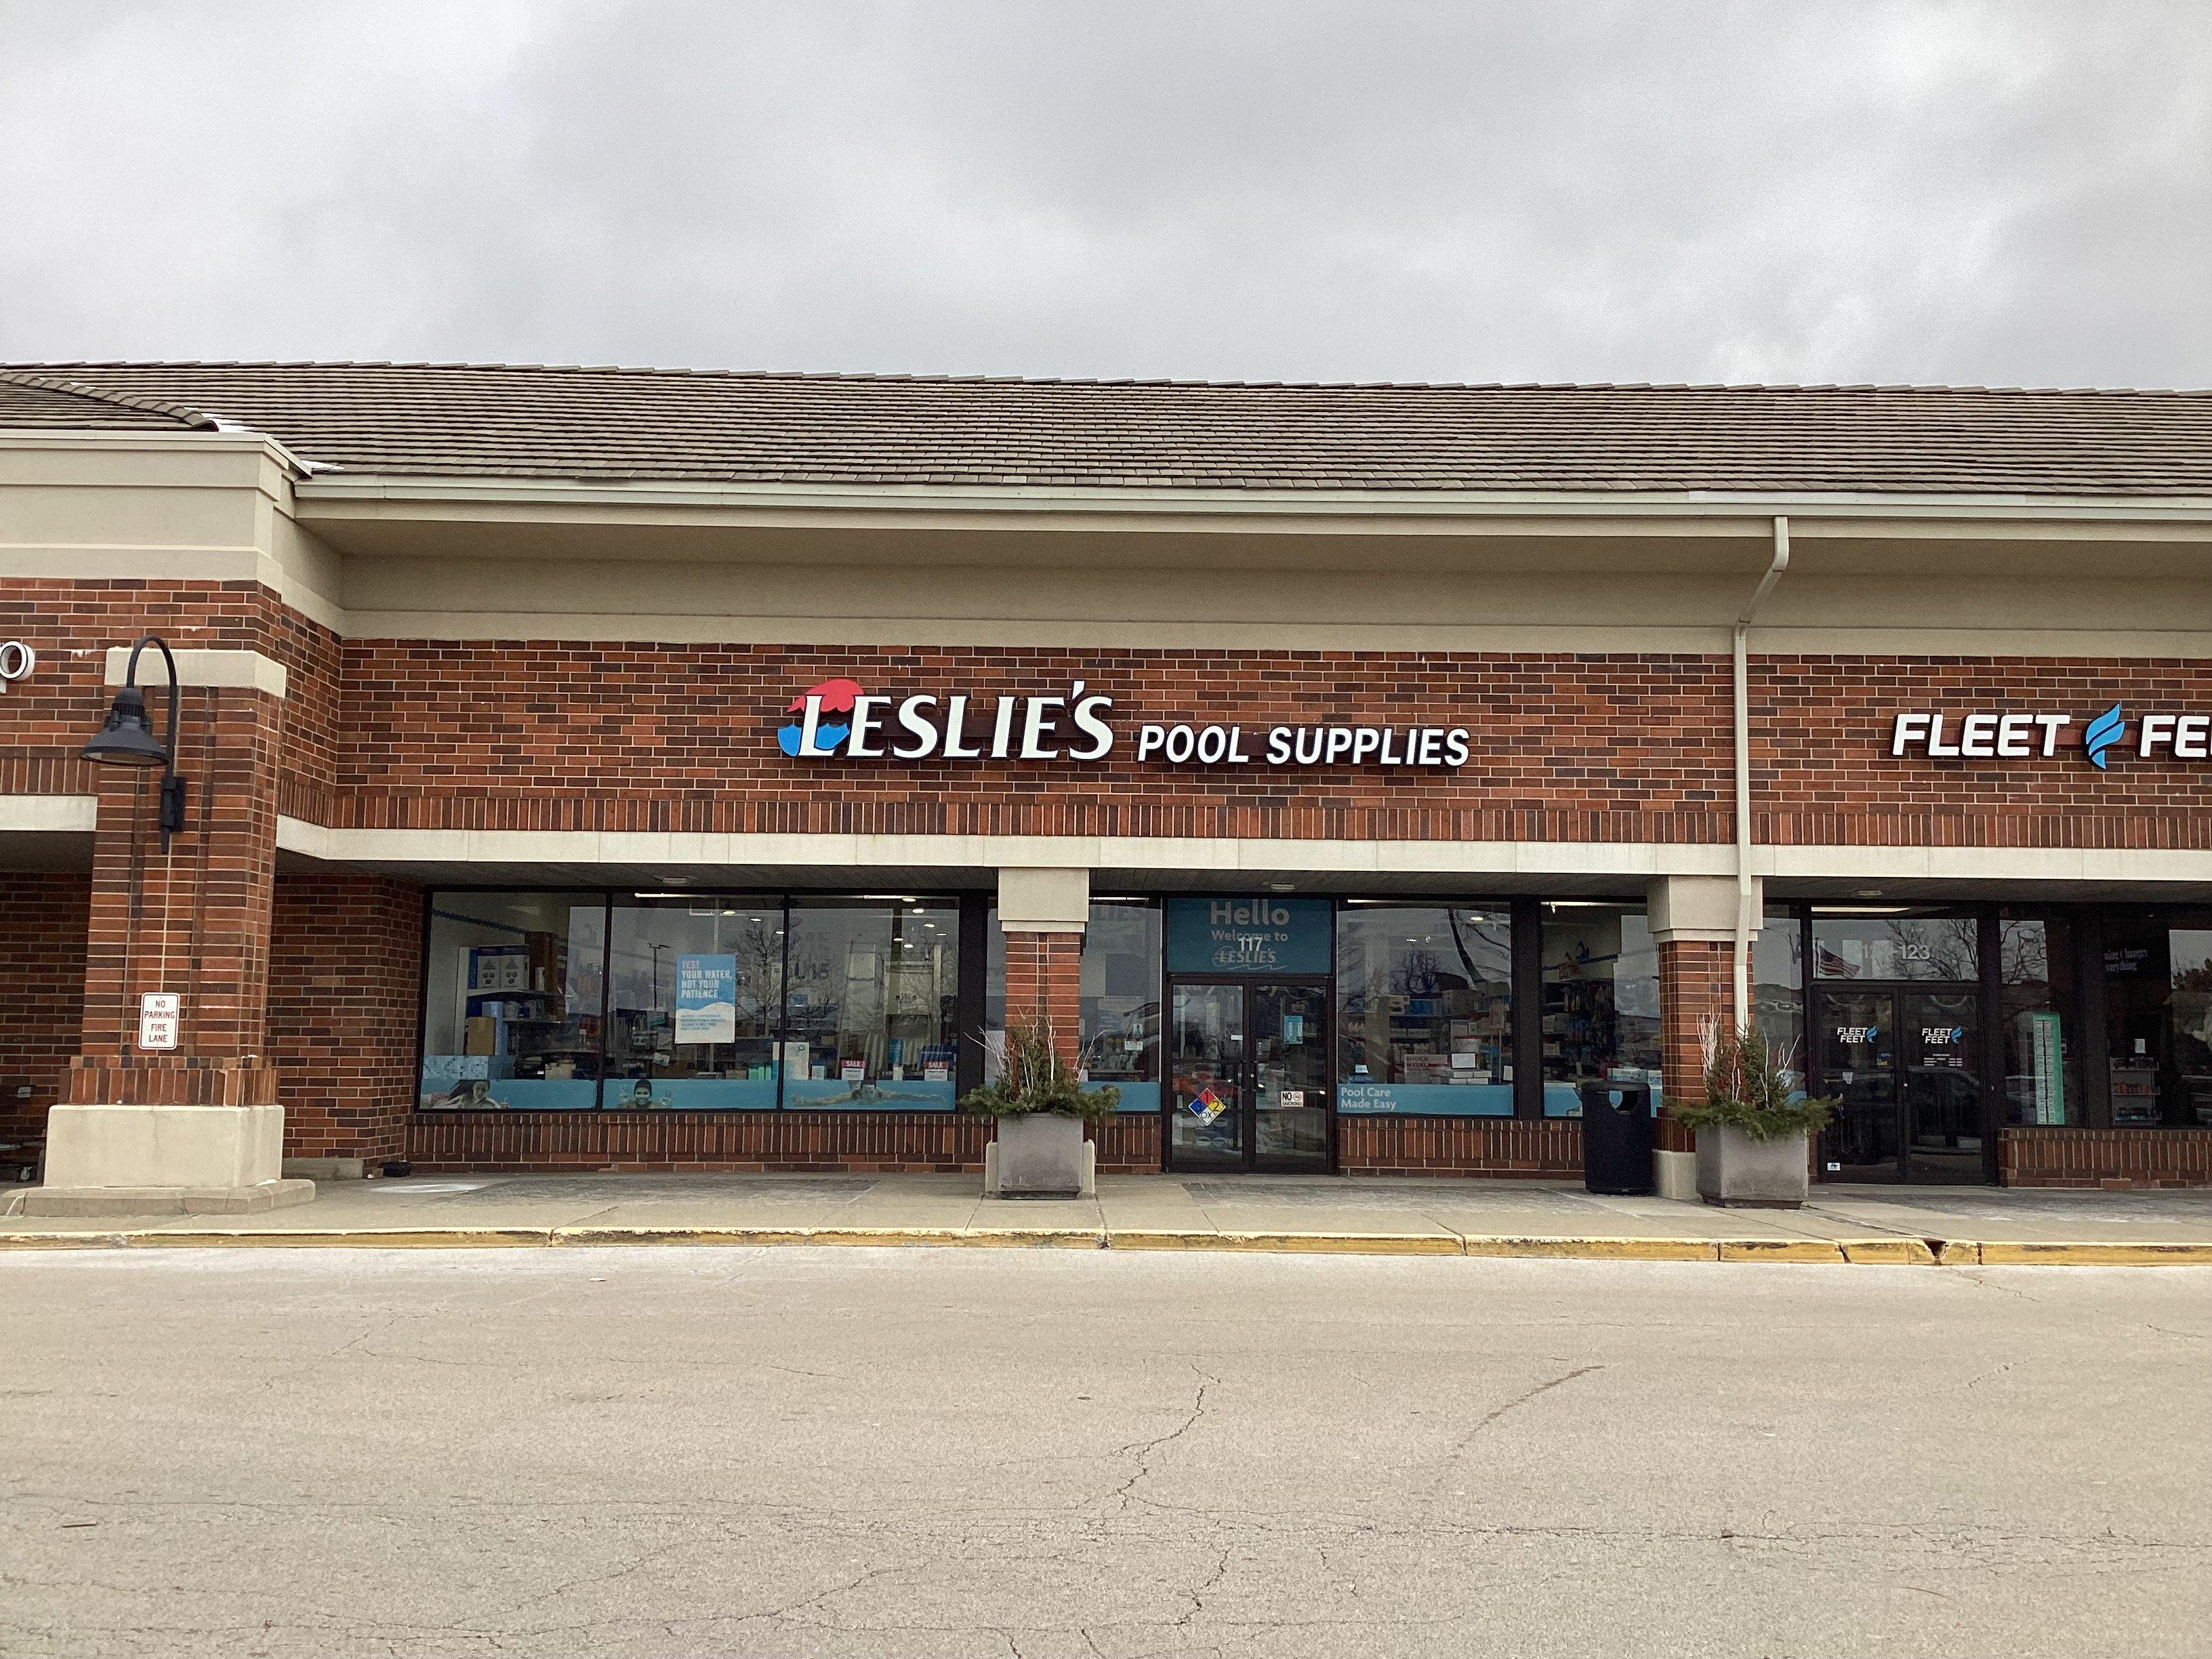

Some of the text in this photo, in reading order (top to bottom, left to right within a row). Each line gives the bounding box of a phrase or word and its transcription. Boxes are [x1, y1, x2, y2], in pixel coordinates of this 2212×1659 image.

[797, 680, 1471, 766] LESLIE'S POOL SUPPLIES
[1892, 713, 2212, 758] FLEET FE
[1210, 899, 1290, 926] Hello
[1210, 929, 1288, 941] Welcome to
[1237, 937, 1263, 951] 117
[1899, 945, 1931, 960] 123
[682, 960, 700, 970] TEST
[681, 970, 702, 979] YOUR
[681, 980, 720, 989] NOT YOUR
[155, 1000, 166, 1008] NO
[144, 1010, 175, 1019] PARKING
[151, 1023, 167, 1031] FIRE
[1837, 1027, 1868, 1036] FLEET
[1922, 1027, 1952, 1036] FLEET
[148, 1034, 167, 1043] LANE
[1840, 1035, 1866, 1044] FEET
[1925, 1036, 1950, 1044] FEET
[1282, 1092, 1292, 1101] NO
[1340, 1087, 1391, 1097] Pool Care
[1212, 1100, 1221, 1112] 2
[1340, 1098, 1396, 1111] Made Easy
